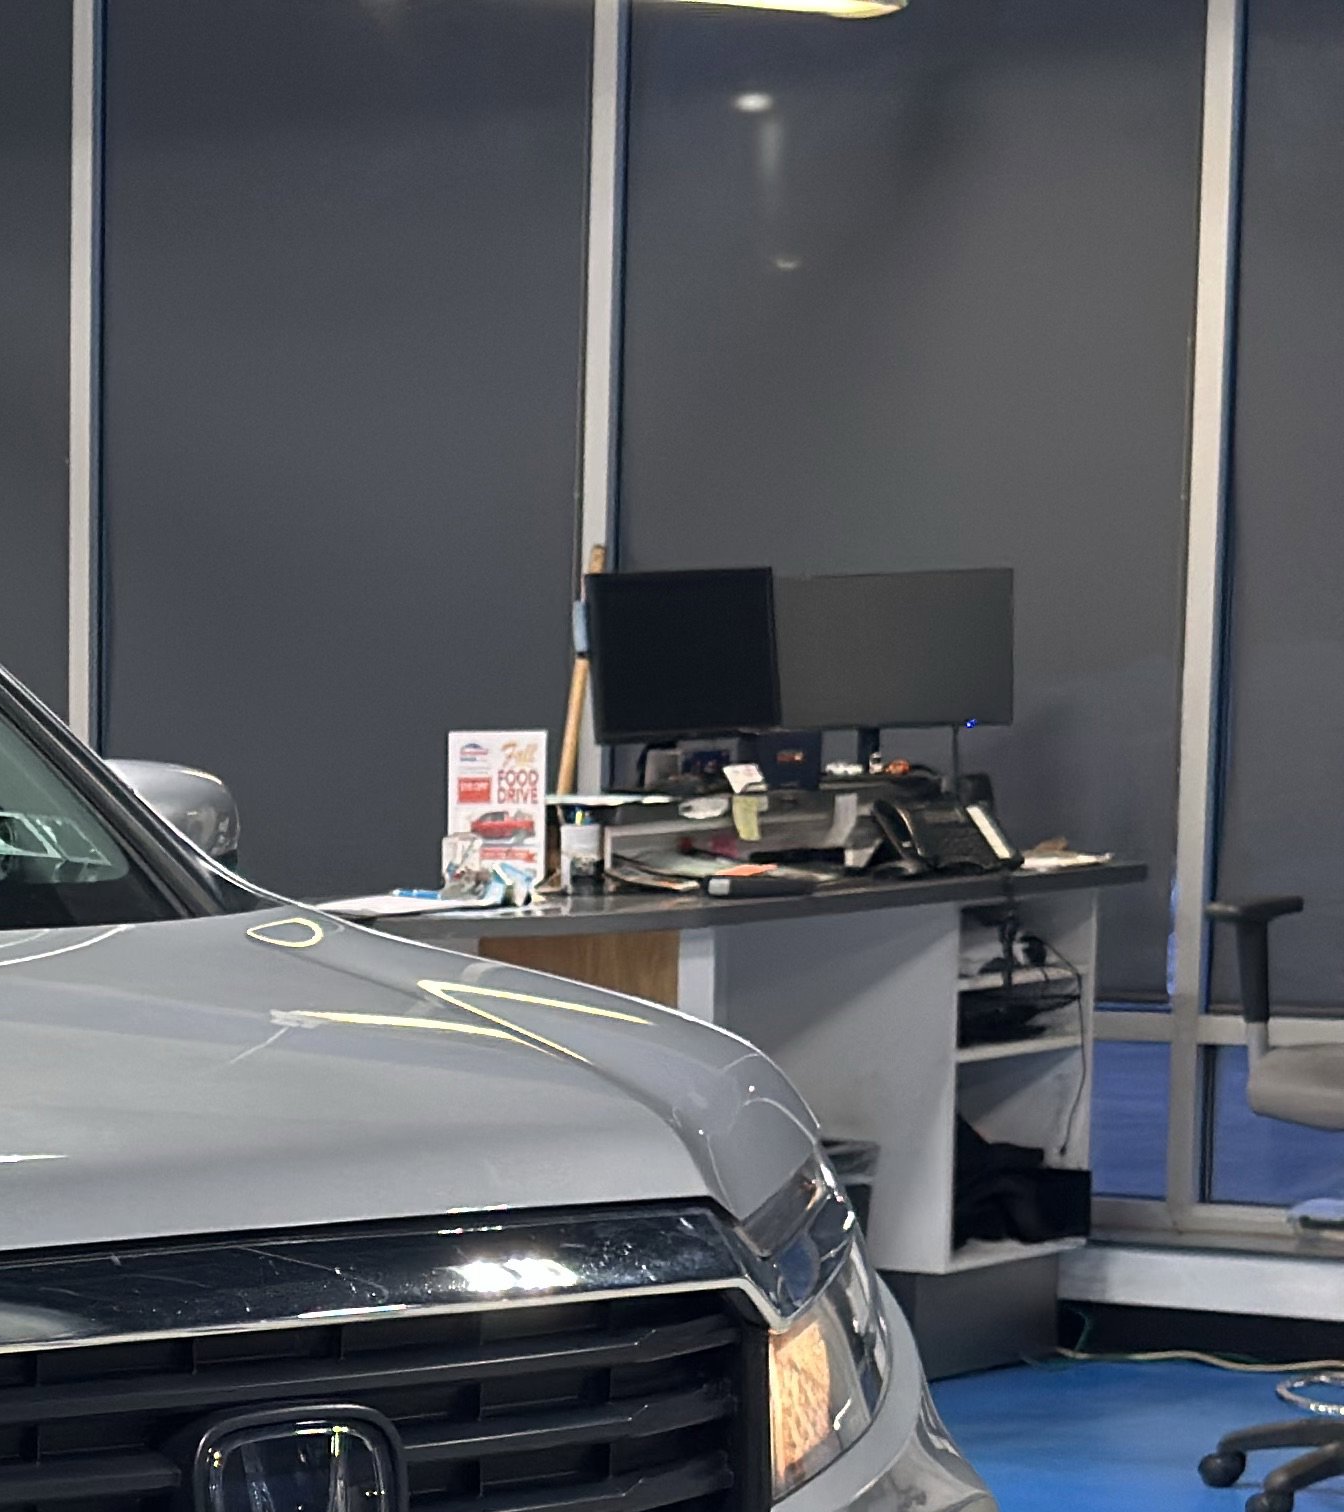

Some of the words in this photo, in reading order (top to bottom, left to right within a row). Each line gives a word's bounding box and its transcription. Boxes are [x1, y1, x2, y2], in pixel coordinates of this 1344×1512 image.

[501, 741, 539, 768] Fall
[498, 770, 539, 786] FOOD
[497, 788, 539, 804] DRIVE
